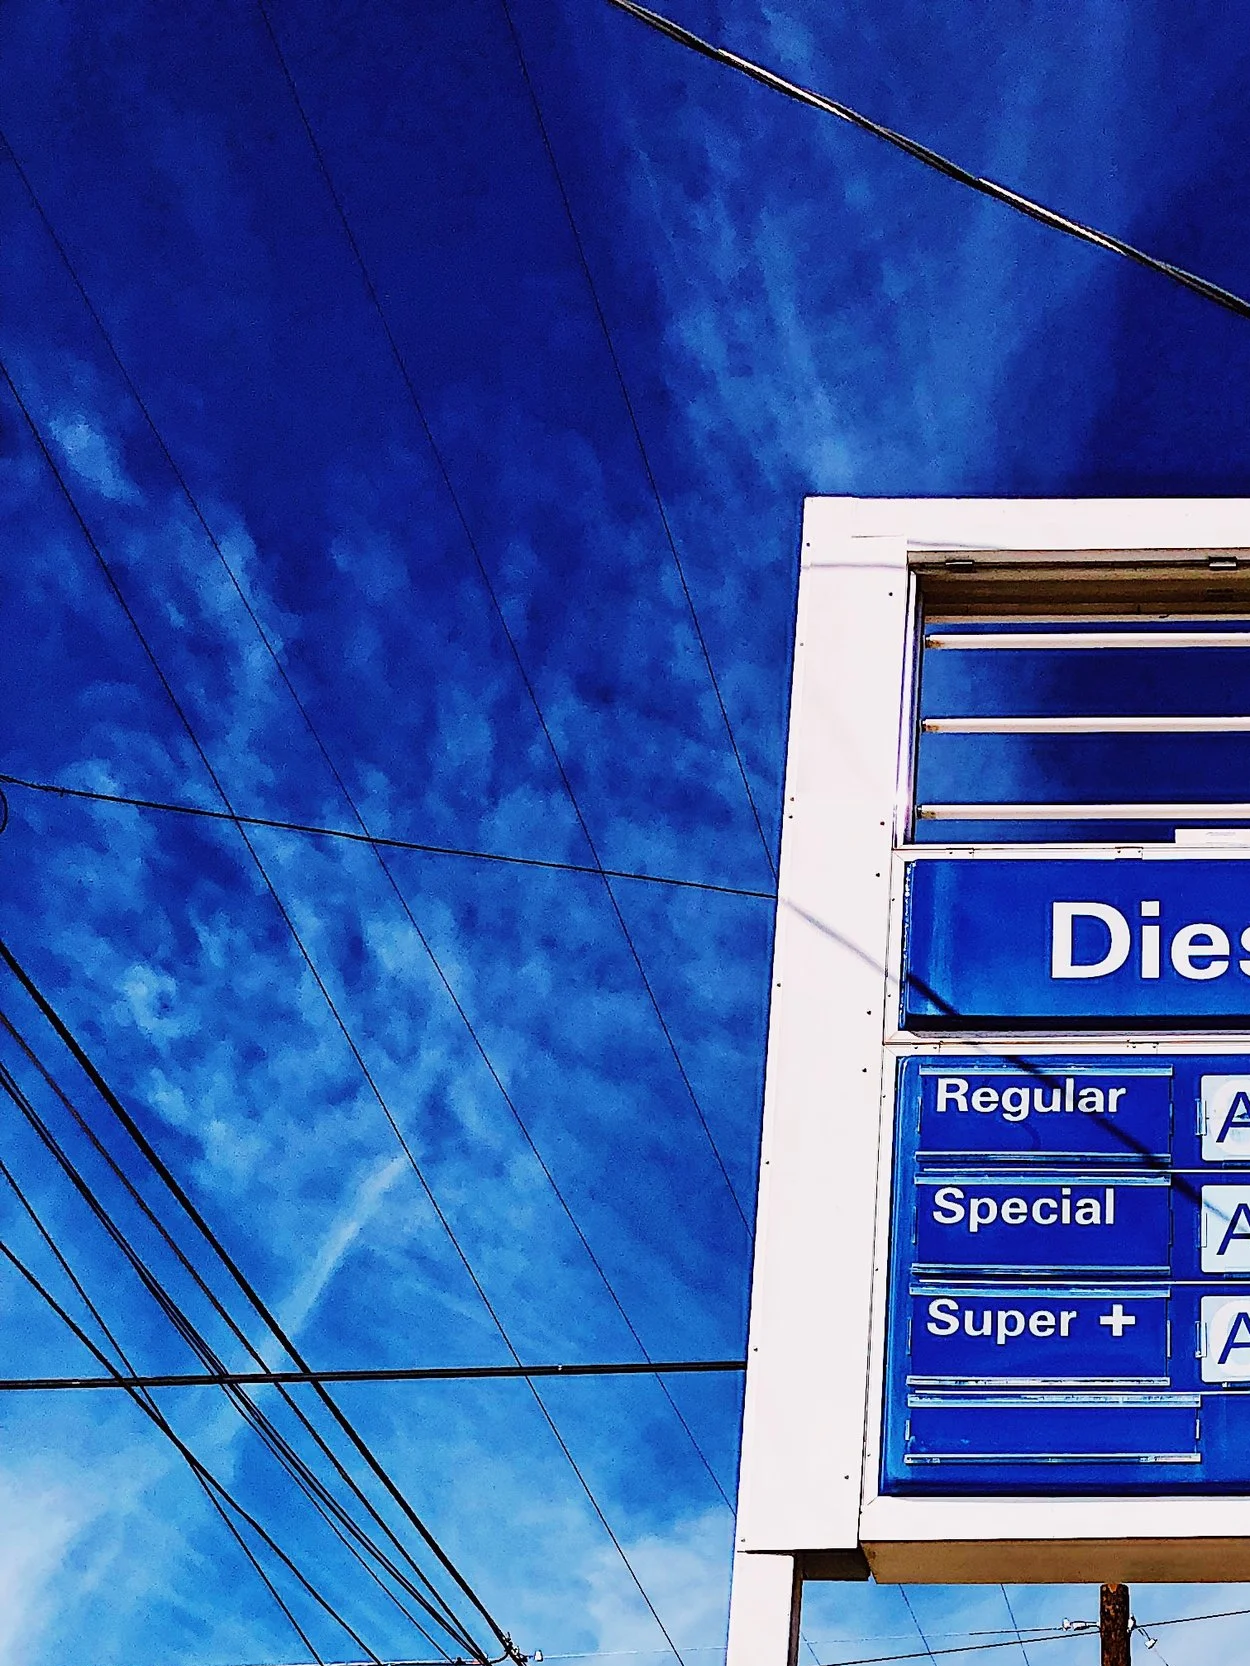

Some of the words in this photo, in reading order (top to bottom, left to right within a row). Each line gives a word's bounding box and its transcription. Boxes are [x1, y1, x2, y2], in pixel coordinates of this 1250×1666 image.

[936, 1078, 1126, 1122] Regular
[933, 1186, 1114, 1231] Special
[927, 1298, 1077, 1345] Super
[1099, 1304, 1136, 1337] +
